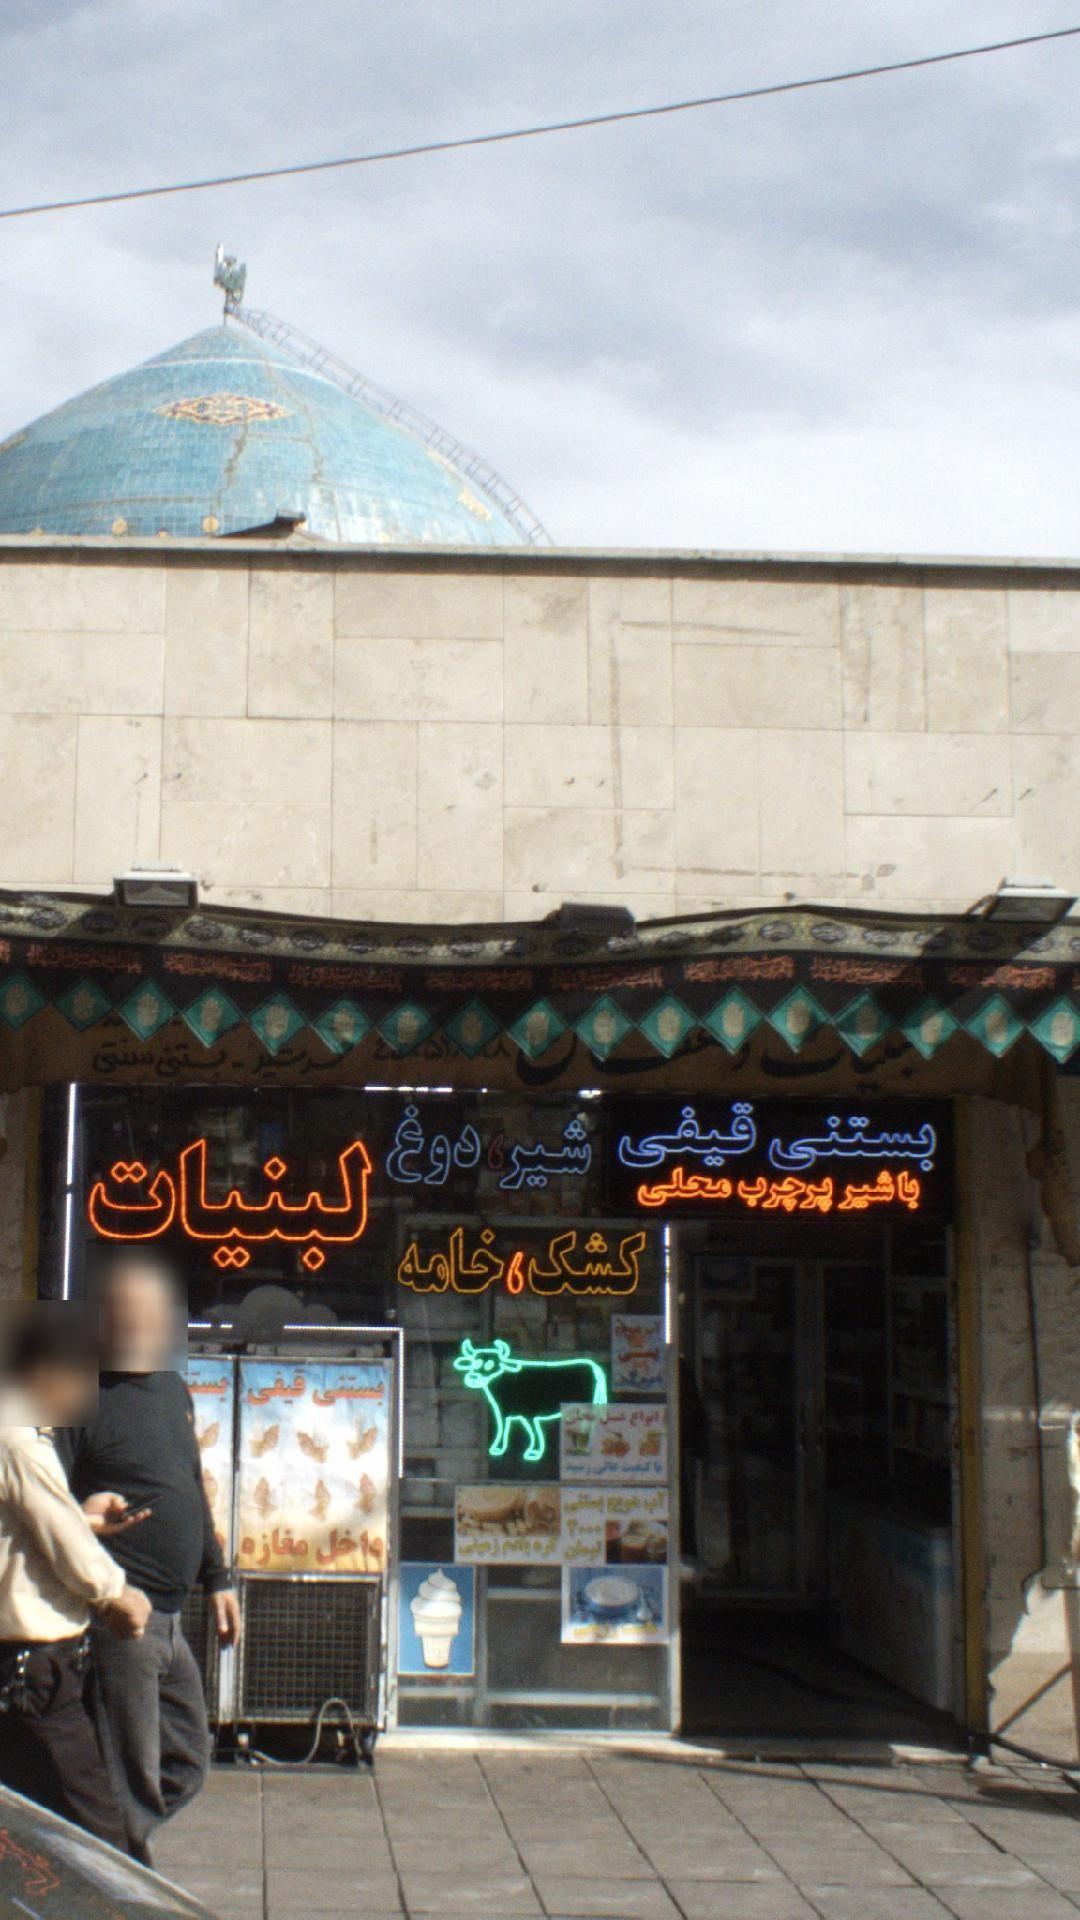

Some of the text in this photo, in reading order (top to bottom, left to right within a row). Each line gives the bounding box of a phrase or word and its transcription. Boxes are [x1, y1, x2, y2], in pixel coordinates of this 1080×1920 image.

[386, 1104, 481, 1184] دوغ
[500, 1120, 592, 1189] شیر
[618, 1102, 936, 1171] بستنی قیفی
[90, 1138, 372, 1270] لبنیات
[637, 1167, 732, 1206] محلی
[397, 1227, 504, 1294] خامه
[528, 1230, 646, 1295] کشک
[247, 1368, 385, 1407] بستنی قیفی
[240, 1527, 384, 1567] داخل مغازه
